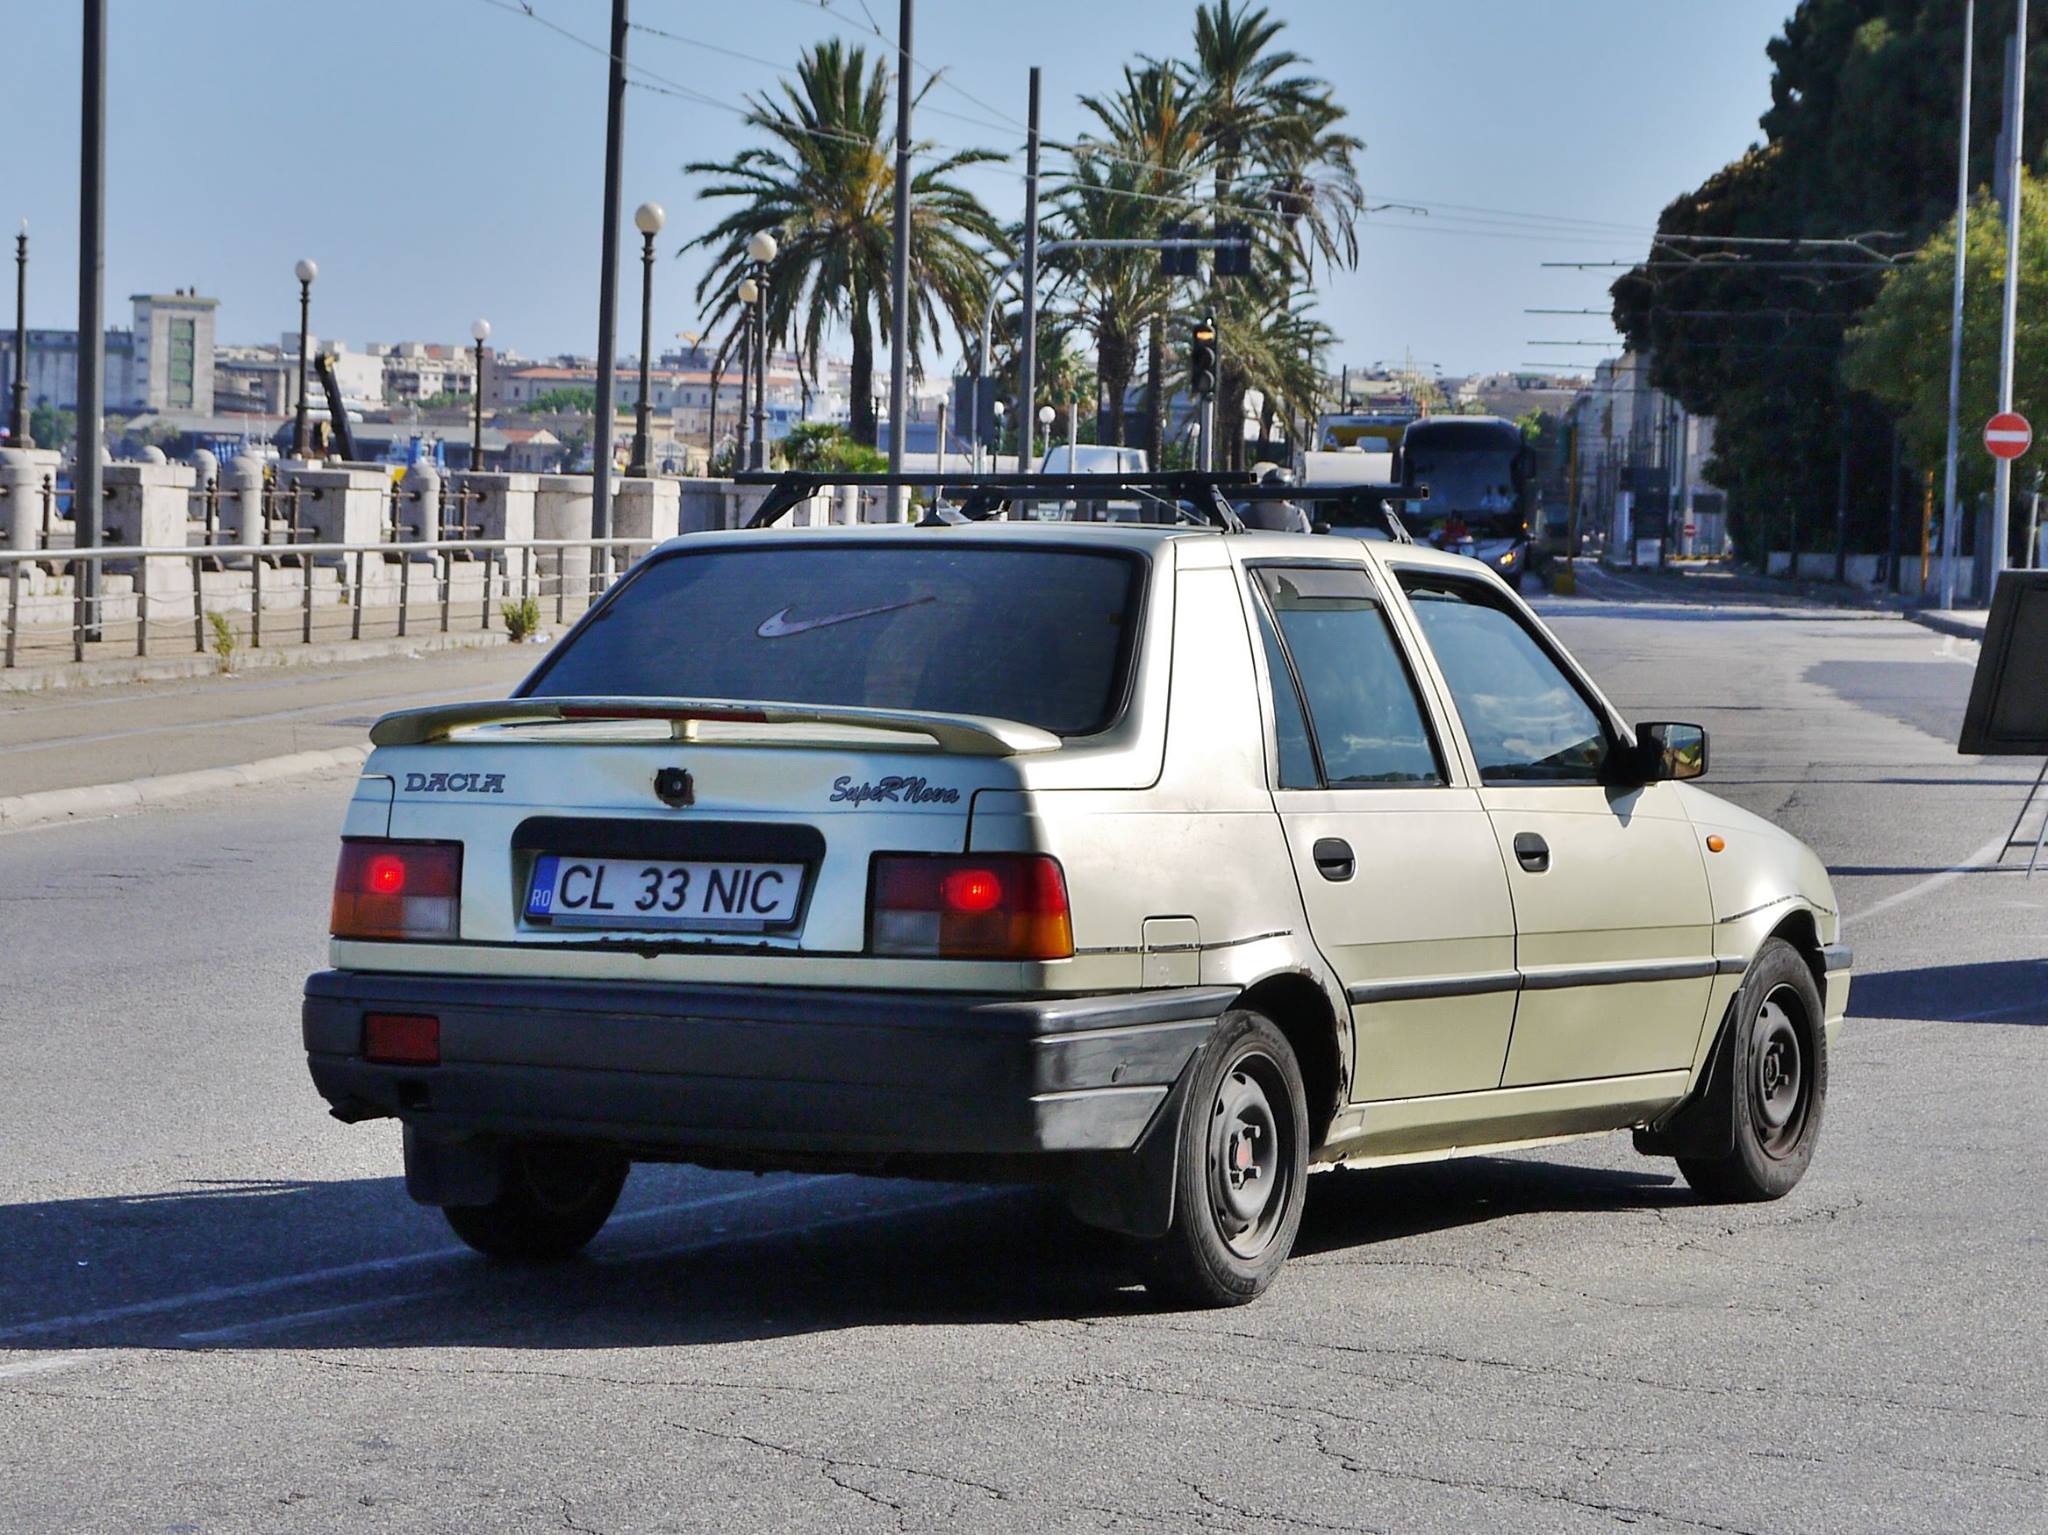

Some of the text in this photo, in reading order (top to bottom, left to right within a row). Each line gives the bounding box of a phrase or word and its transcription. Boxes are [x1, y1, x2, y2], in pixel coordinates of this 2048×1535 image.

[404, 772, 506, 793] DACIA
[530, 888, 551, 907] RO
[559, 864, 784, 914] CL 33 NIC
